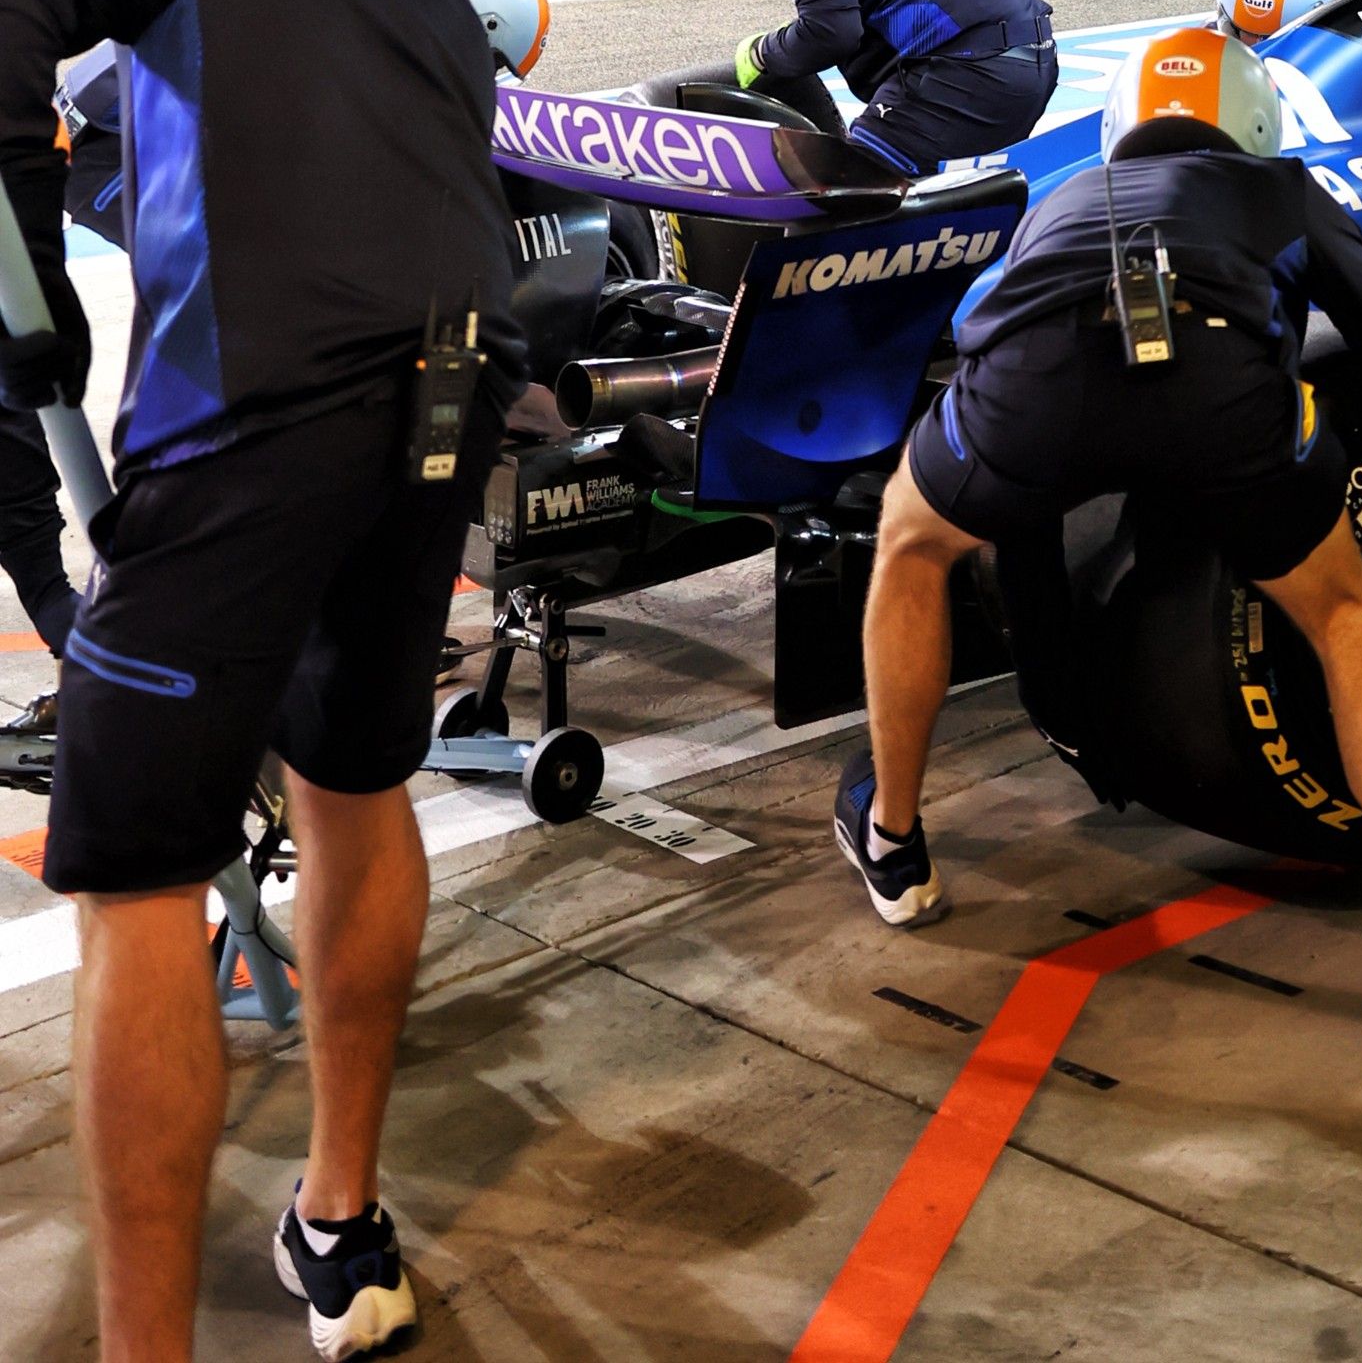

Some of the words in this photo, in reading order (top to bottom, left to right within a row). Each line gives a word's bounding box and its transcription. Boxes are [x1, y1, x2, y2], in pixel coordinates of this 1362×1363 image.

[1160, 60, 1198, 72] BELL
[509, 95, 766, 192] kraken
[772, 227, 1000, 299] KOMATSU
[586, 475, 621, 491] FRANK
[586, 482, 636, 503] WILLIAMS
